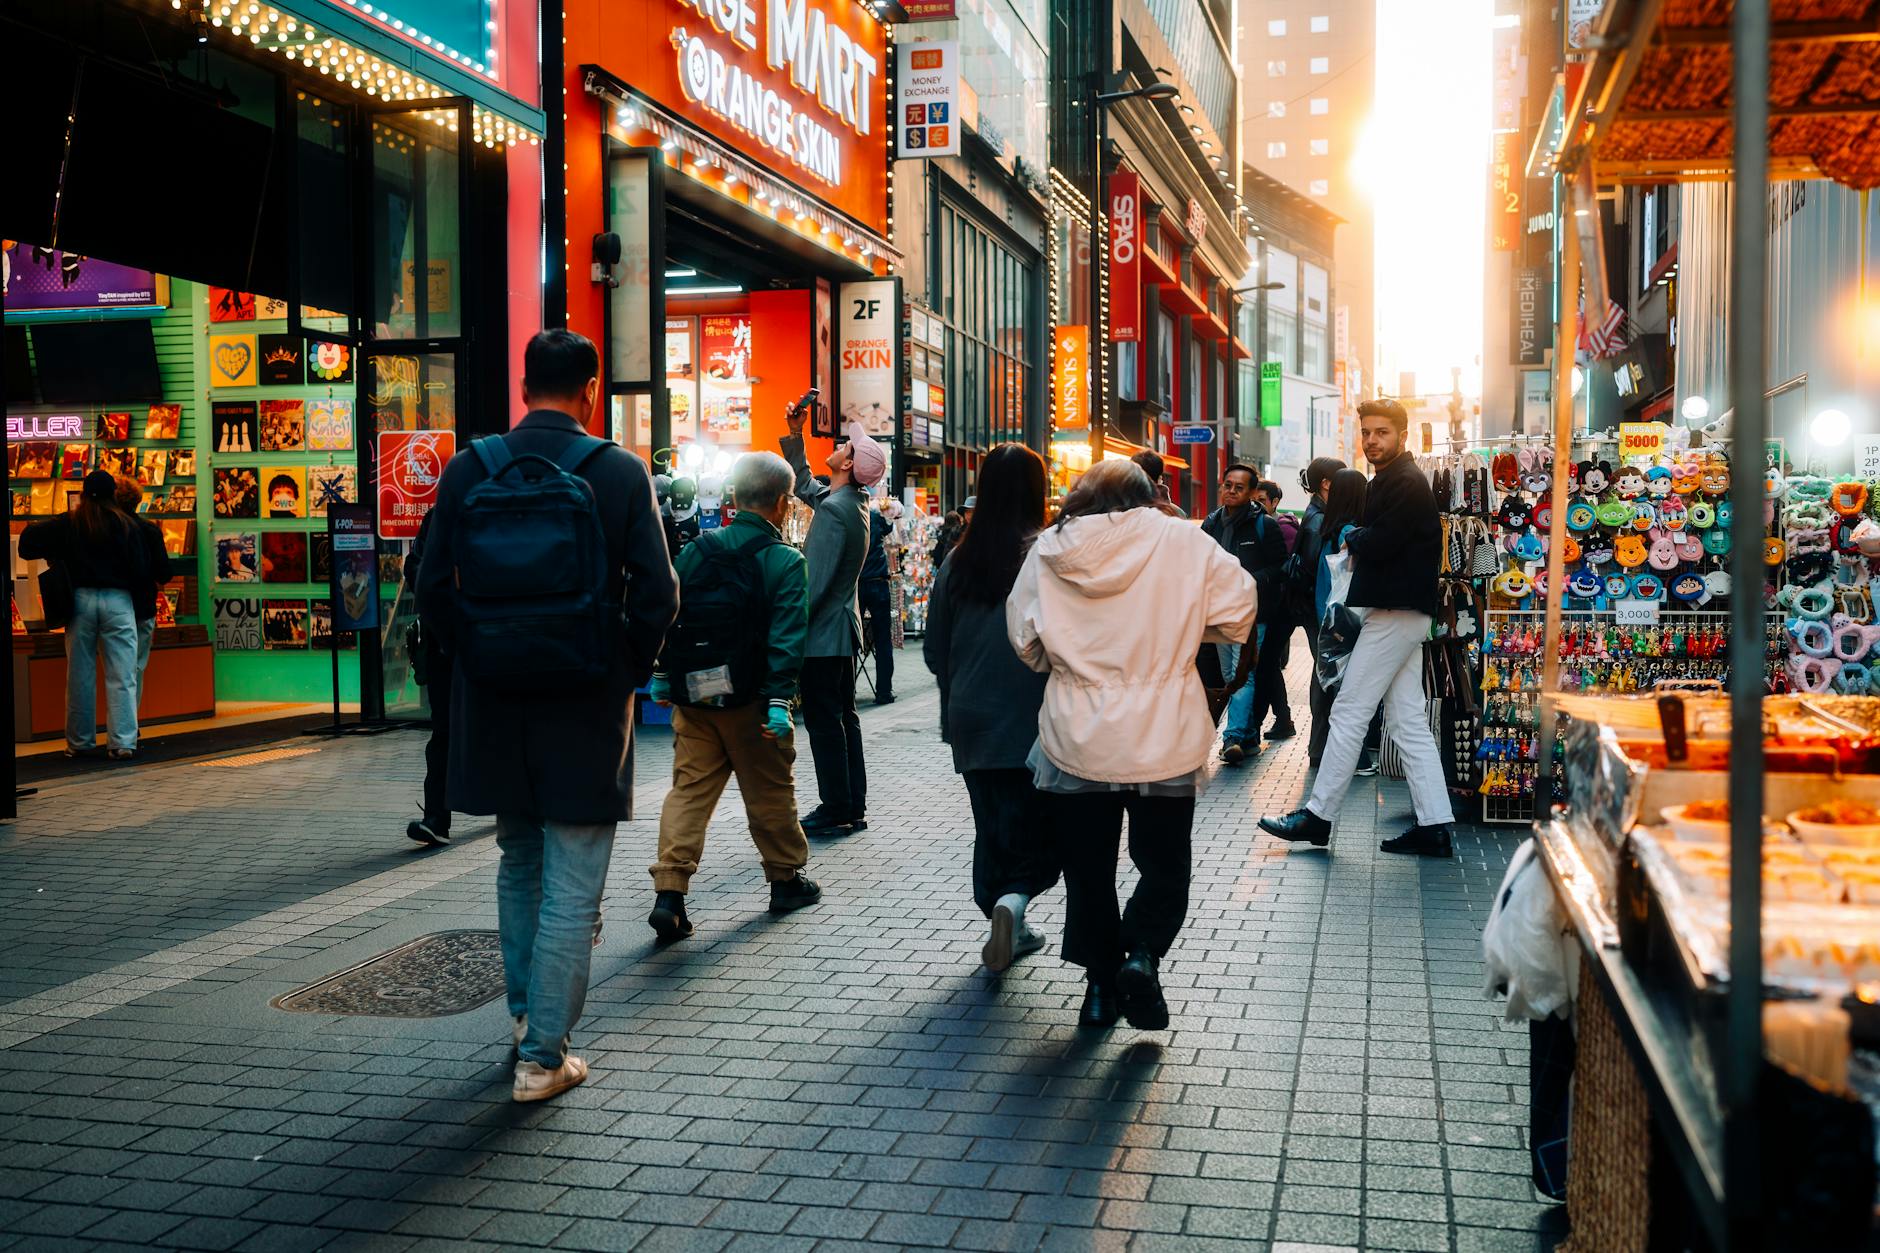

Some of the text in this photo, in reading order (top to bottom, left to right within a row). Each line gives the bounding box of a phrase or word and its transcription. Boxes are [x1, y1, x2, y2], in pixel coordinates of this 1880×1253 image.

[771, 0, 876, 136] MART
[912, 76, 942, 85] MONEY
[904, 86, 950, 97] EXCHANGE
[683, 36, 840, 186] ORANGE SKIN
[908, 106, 922, 123] 元
[910, 128, 921, 147] $
[1113, 194, 1134, 264] SPAO
[1528, 213, 1553, 234] JUNO
[853, 300, 880, 320] 2F
[1520, 277, 1534, 360] MEDIHEAL
[846, 339, 888, 348] ORANGE
[843, 349, 891, 369] SKIN
[1064, 358, 1077, 421] SUNSKIN
[1625, 435, 1659, 447] 5000
[404, 461, 432, 474] TAX
[404, 476, 432, 485] FREE
[335, 519, 353, 529] K-POP
[215, 599, 259, 618] YOU
[1618, 610, 1650, 620] 3,000
